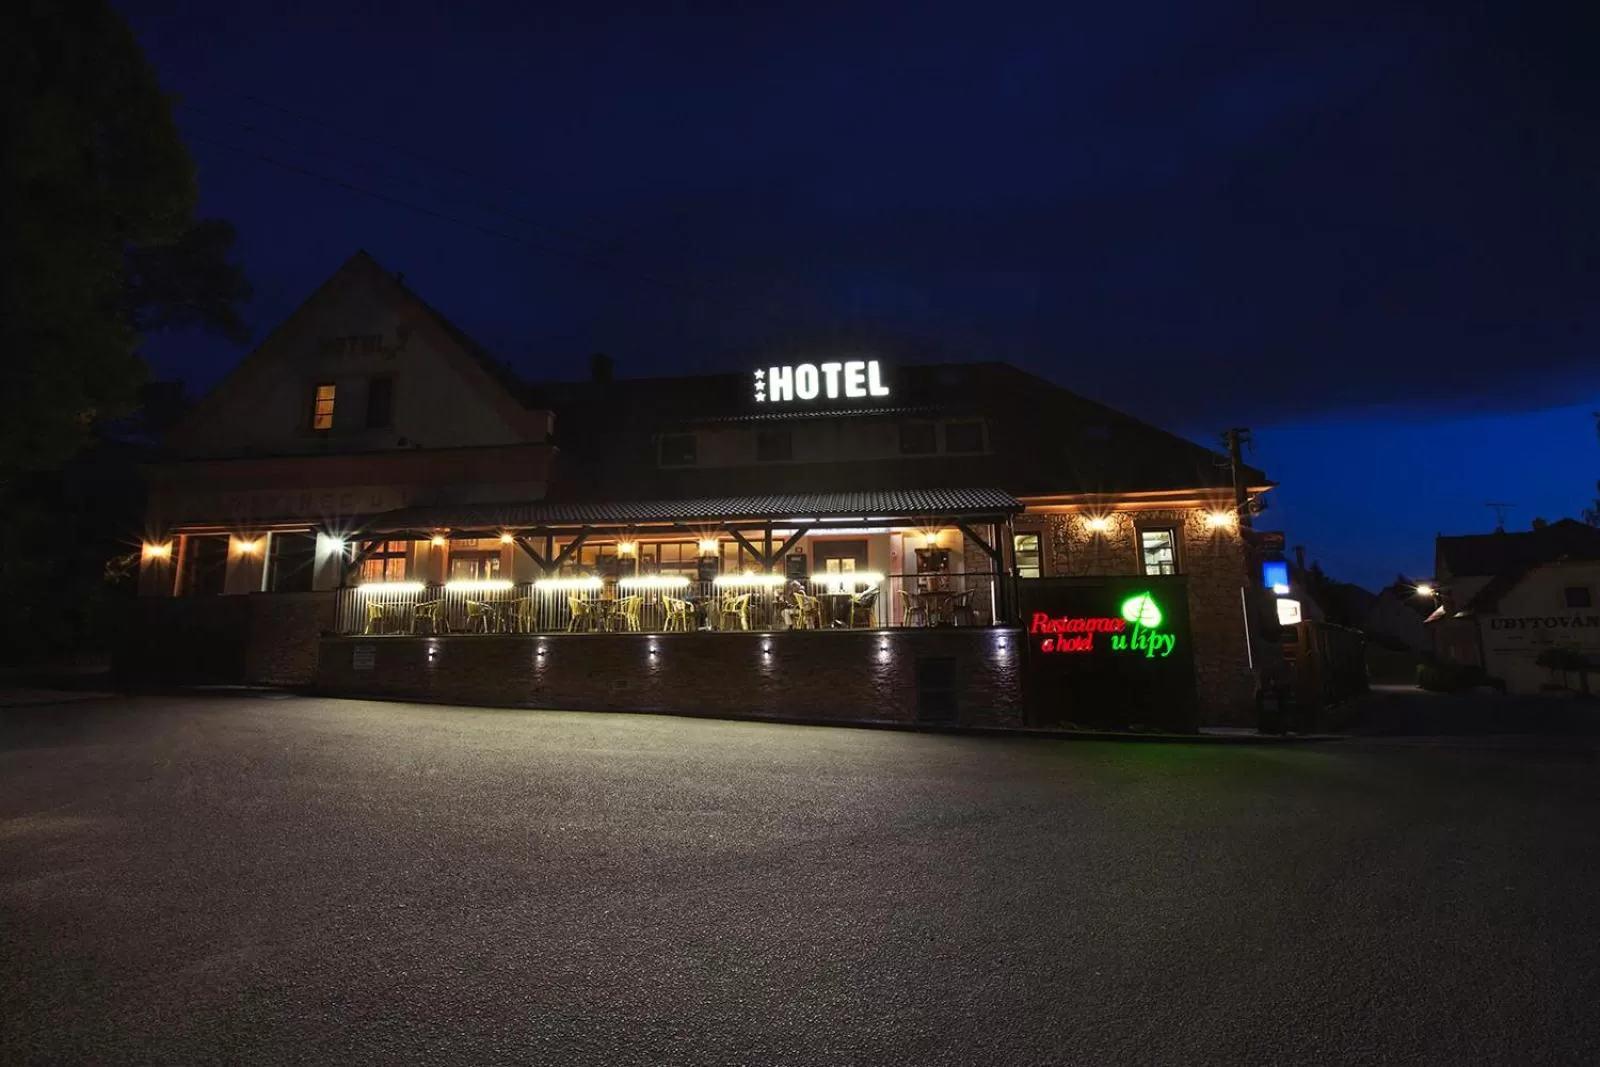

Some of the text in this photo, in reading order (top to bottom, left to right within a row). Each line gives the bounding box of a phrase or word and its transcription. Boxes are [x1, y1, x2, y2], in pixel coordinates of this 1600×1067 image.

[769, 360, 889, 402] HOTEL
[1030, 612, 1127, 634] Restaurace
[1041, 632, 1094, 653] a hotel
[1111, 622, 1176, 658] u lípy
